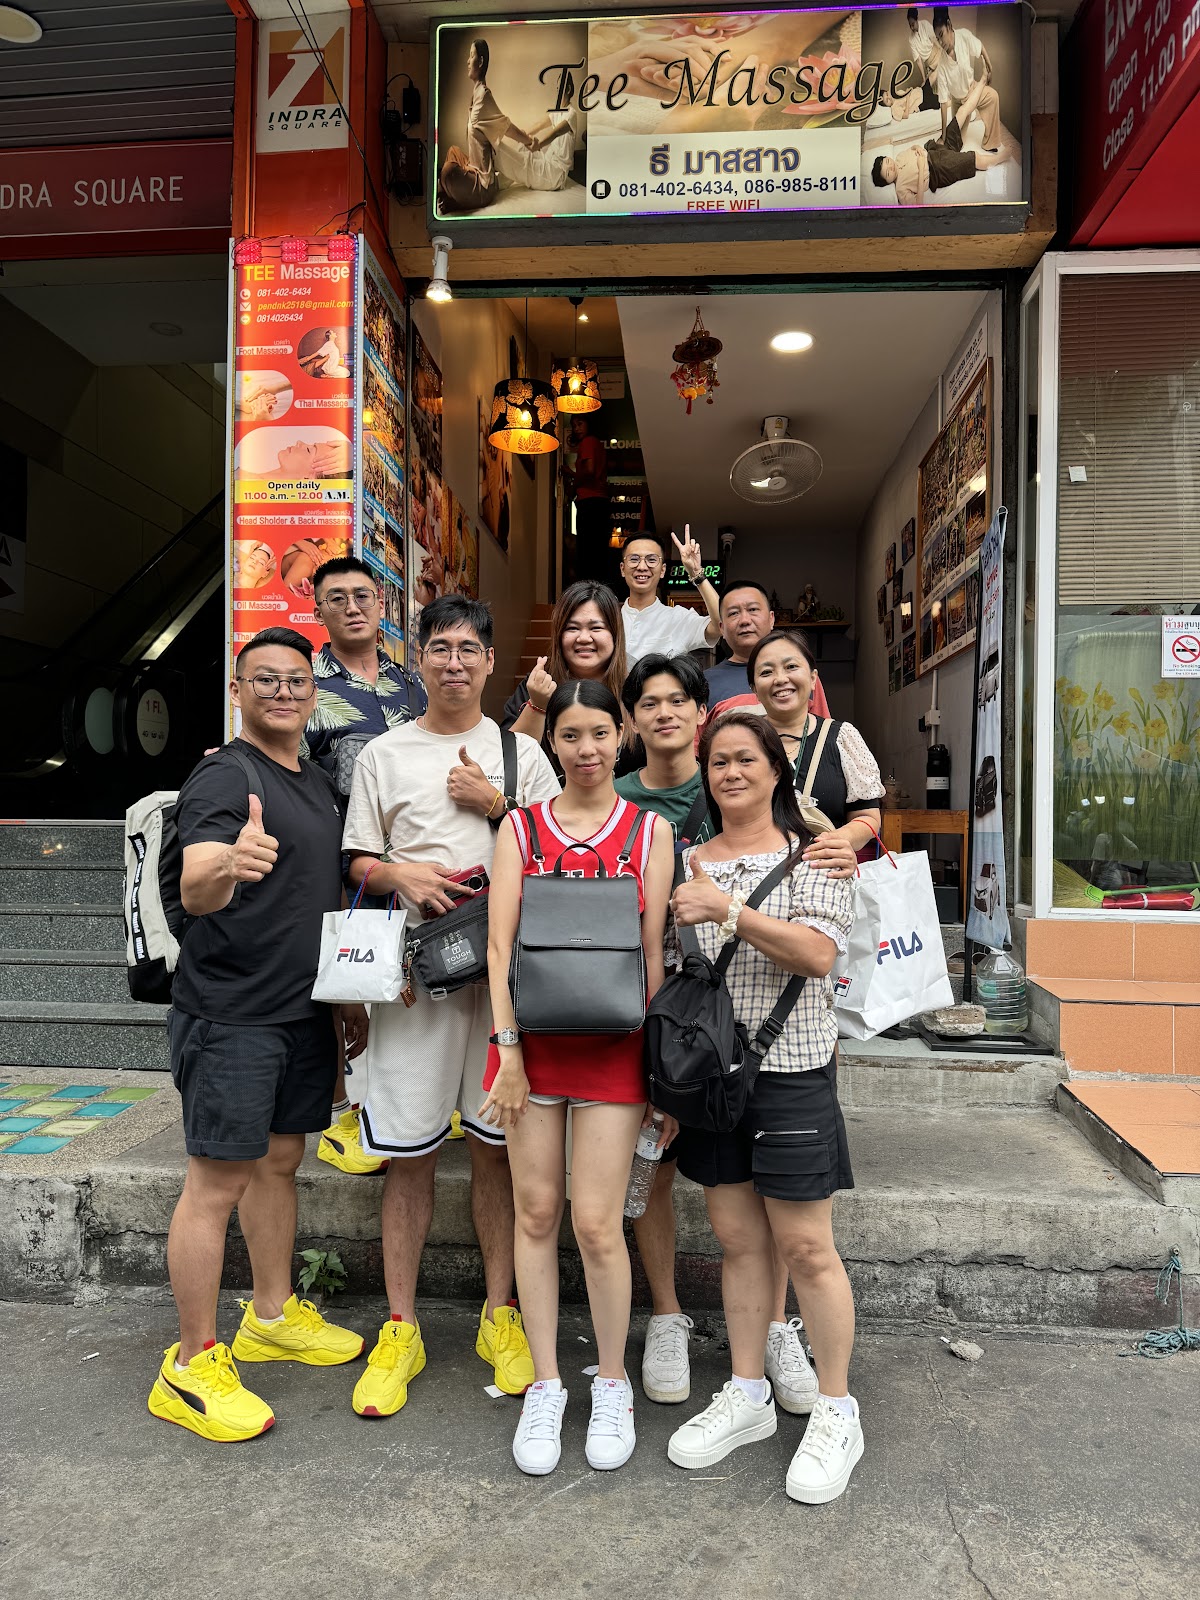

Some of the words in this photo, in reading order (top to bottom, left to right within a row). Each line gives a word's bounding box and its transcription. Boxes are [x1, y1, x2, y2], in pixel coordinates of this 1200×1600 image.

[538, 58, 628, 114] Tee
[659, 49, 914, 124] Massage
[1108, 49, 1138, 115] Open
[1103, 107, 1134, 171] Close
[1141, 33, 1175, 113] 11.00
[268, 108, 343, 124] INDRA
[268, 119, 342, 131] SQUARE
[650, 143, 670, 176] ธี
[682, 146, 801, 176] มาสสาจ
[74, 175, 184, 207] SQUARE
[619, 181, 738, 198] 081-402-6434,
[744, 176, 857, 195] 086-985-8111
[687, 200, 724, 211] FREE
[730, 199, 760, 211] WIFI
[243, 265, 275, 281] TEE
[280, 264, 350, 282] Massage
[257, 288, 311, 297] 081-402-6434
[256, 313, 303, 322] 0814026434
[239, 347, 254, 355] Foot
[256, 347, 288, 355] Massage
[316, 400, 349, 408] Massage
[268, 482, 293, 490] Open
[295, 481, 320, 491] daily
[297, 492, 322, 500] 12.00
[324, 491, 350, 500] A.M.
[239, 517, 257, 525] Head
[259, 516, 287, 525] Sholder
[290, 517, 295, 525] &
[298, 516, 315, 525] Back
[318, 517, 350, 526] massage
[249, 602, 281, 611] Massage
[877, 931, 923, 965] FILA
[336, 948, 375, 963] FILA
[447, 950, 471, 963] TOUGH
